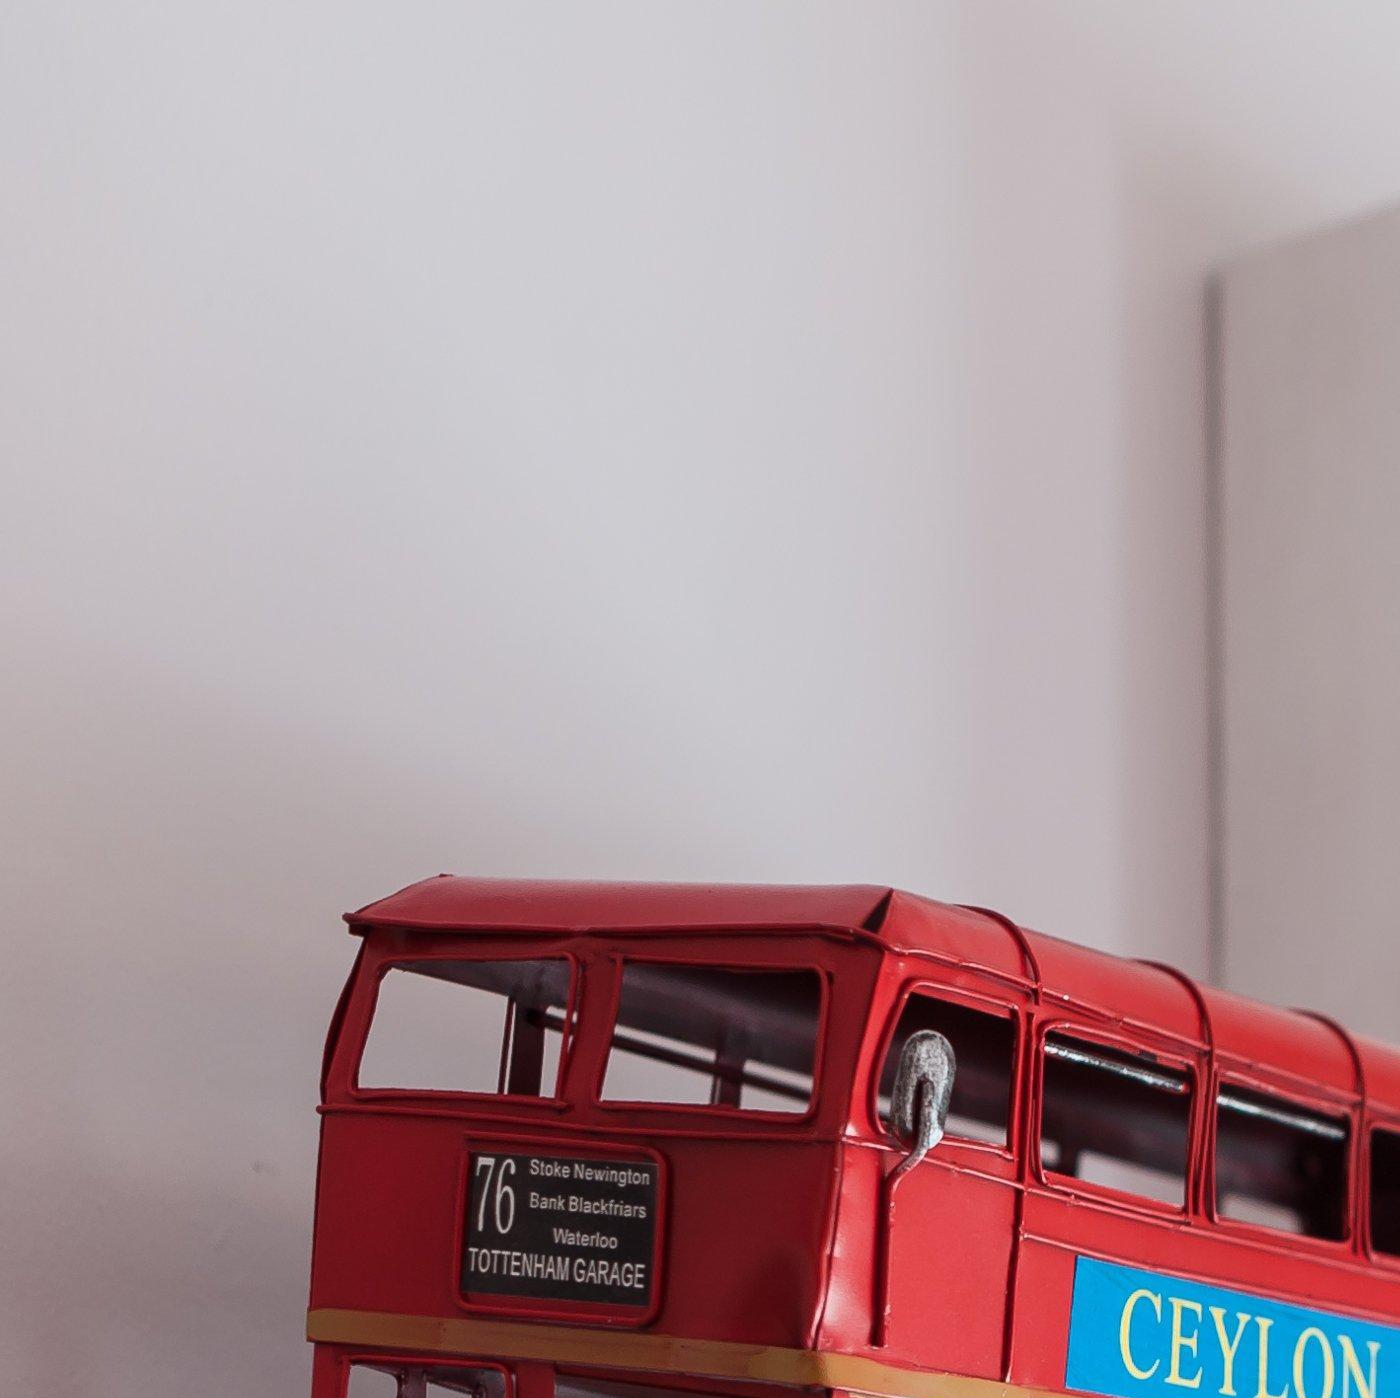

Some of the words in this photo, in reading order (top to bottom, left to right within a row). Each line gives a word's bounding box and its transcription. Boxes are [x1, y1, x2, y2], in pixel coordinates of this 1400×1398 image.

[529, 1159, 571, 1179] Stoke
[574, 1163, 650, 1187] Newington
[476, 1157, 516, 1234] 76
[529, 1192, 565, 1210] Bank
[568, 1196, 647, 1219] Blackfriars
[553, 1228, 618, 1249] Waterloo
[468, 1248, 570, 1281] TOTTENHAM
[573, 1259, 646, 1289] GARAGE
